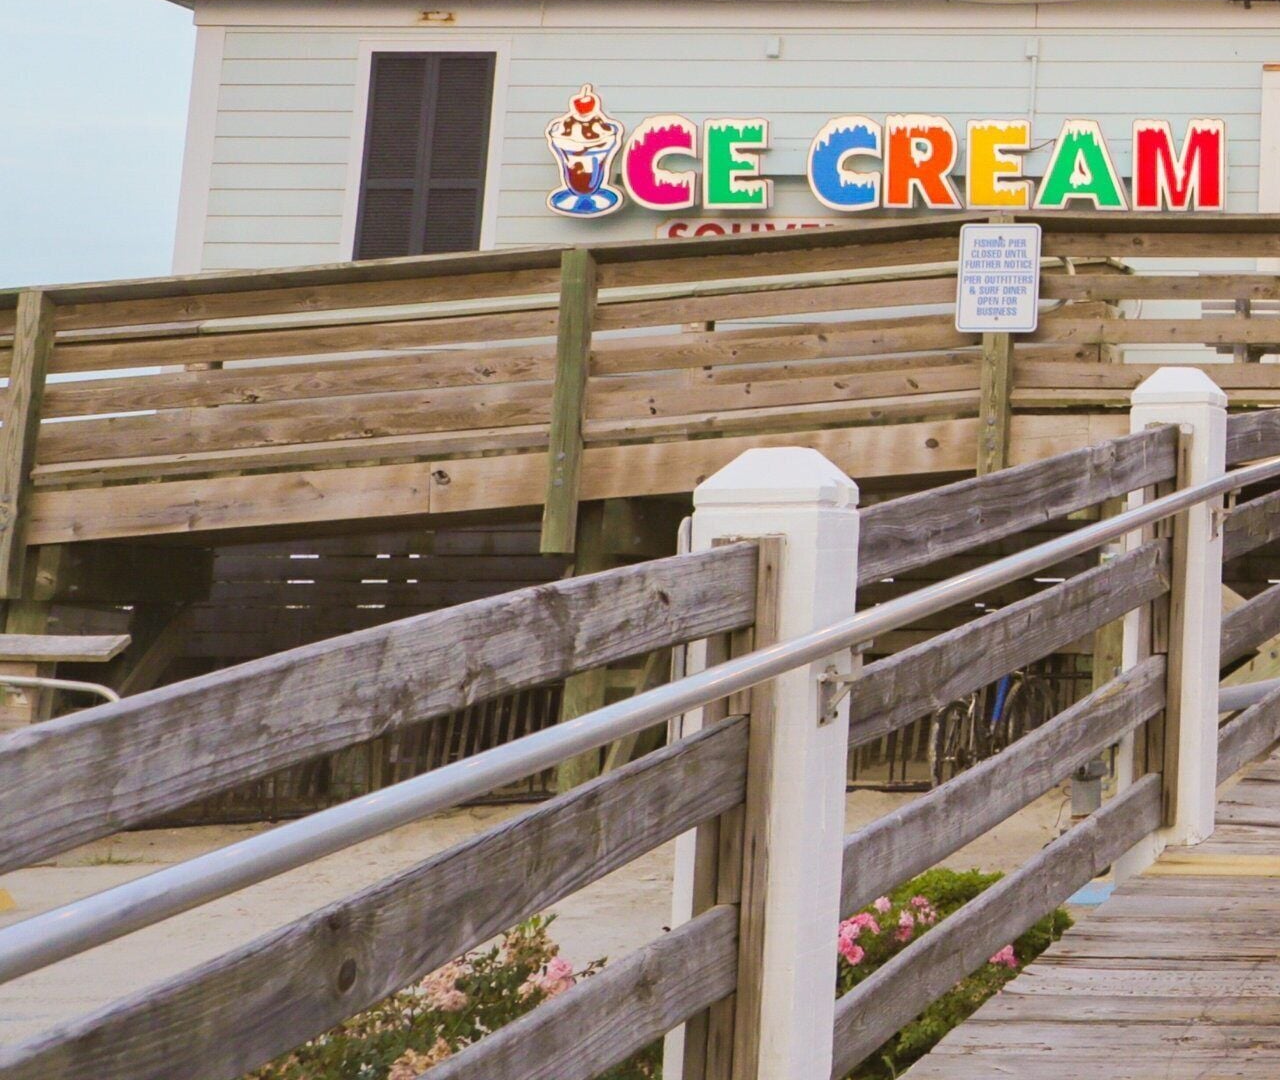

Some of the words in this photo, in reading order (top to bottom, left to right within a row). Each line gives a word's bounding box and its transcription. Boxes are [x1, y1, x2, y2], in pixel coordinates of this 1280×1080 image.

[807, 113, 1226, 211] CREAM
[974, 239, 1006, 248] FISHING
[1008, 239, 1026, 248] PIER
[971, 249, 1002, 258] CLOSED
[1005, 249, 1027, 258] UNTIL
[965, 260, 1001, 269] FURTHER
[1004, 260, 1032, 269] NOTICE
[964, 275, 982, 284] PIER
[984, 275, 1034, 284] OUTFITTERS
[969, 286, 976, 295] &
[979, 286, 1000, 295] SURF
[1003, 286, 1027, 295] DINER
[977, 296, 1000, 305] OPEN
[1002, 296, 1018, 305] FOR
[976, 307, 1017, 316] BUSINESS
